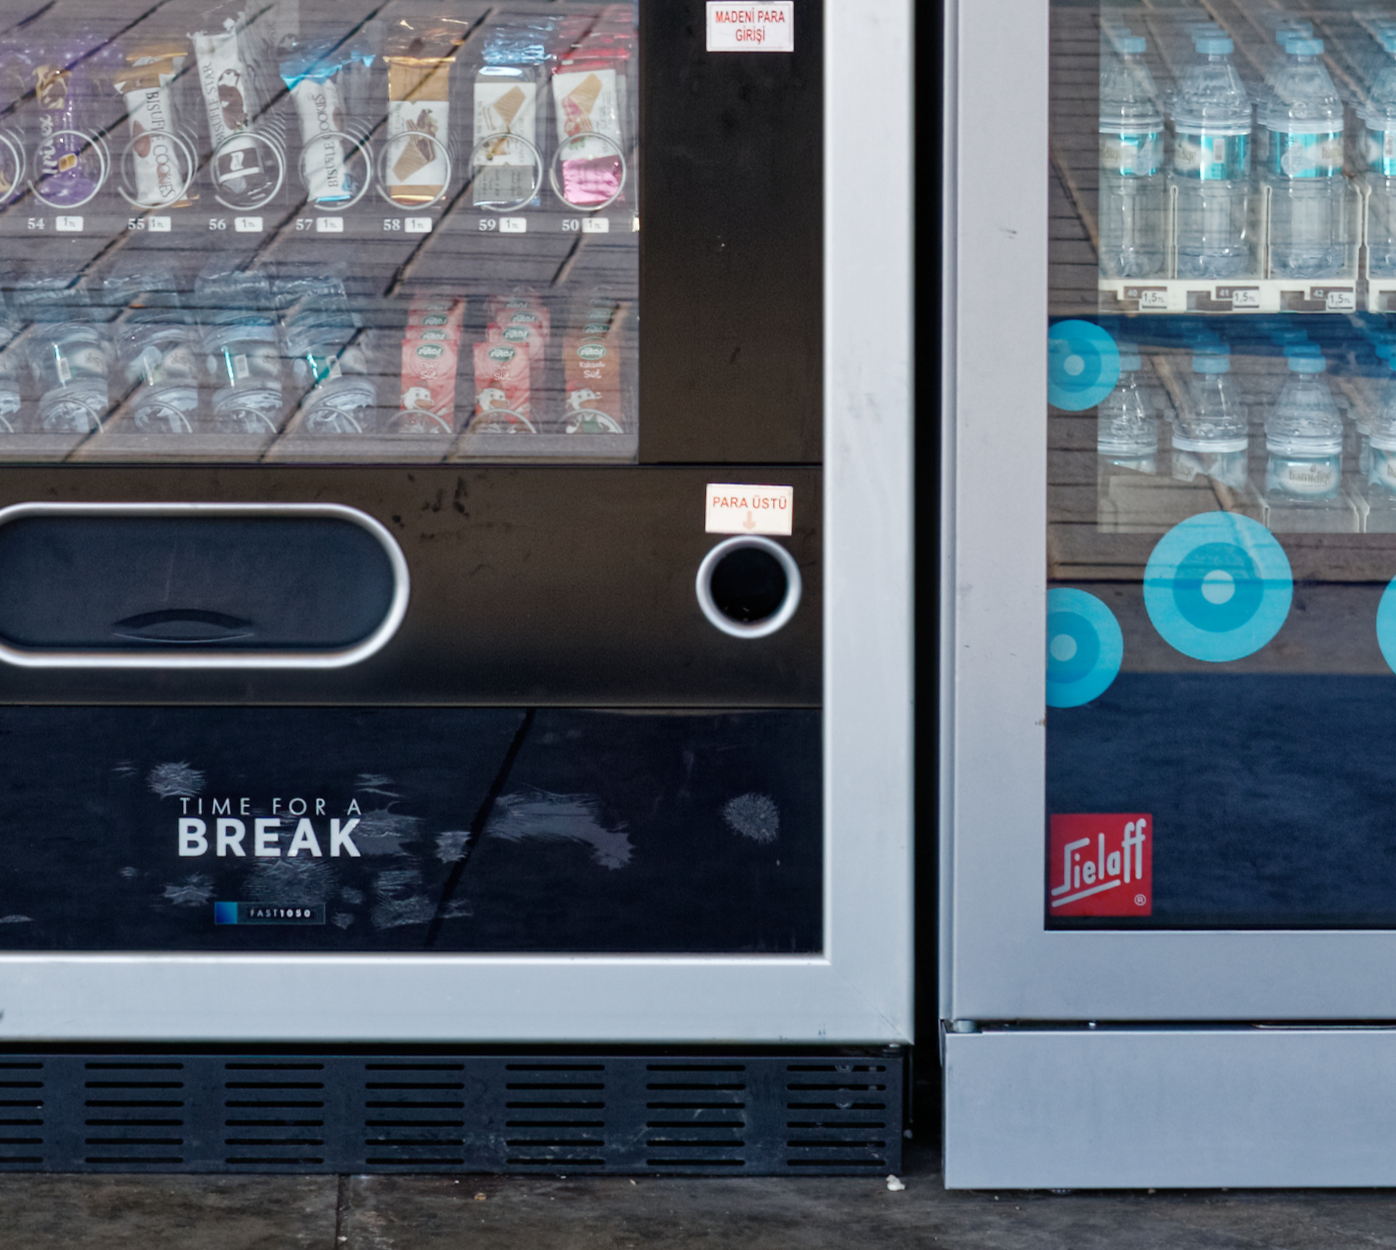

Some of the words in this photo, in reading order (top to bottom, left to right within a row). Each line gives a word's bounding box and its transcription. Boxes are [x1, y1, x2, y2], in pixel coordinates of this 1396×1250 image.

[716, 7, 755, 23] MADENİ
[757, 10, 785, 23] PARA
[736, 25, 765, 44] GİRİŞİ
[478, 219, 496, 230] 59
[713, 496, 748, 508] PARA
[752, 495, 787, 510] ÜSTÜ
[180, 797, 250, 815] TIME
[272, 797, 325, 816] FOR
[347, 797, 361, 815] A
[178, 818, 361, 857] BREAK
[1051, 818, 1147, 896] Sielaff
